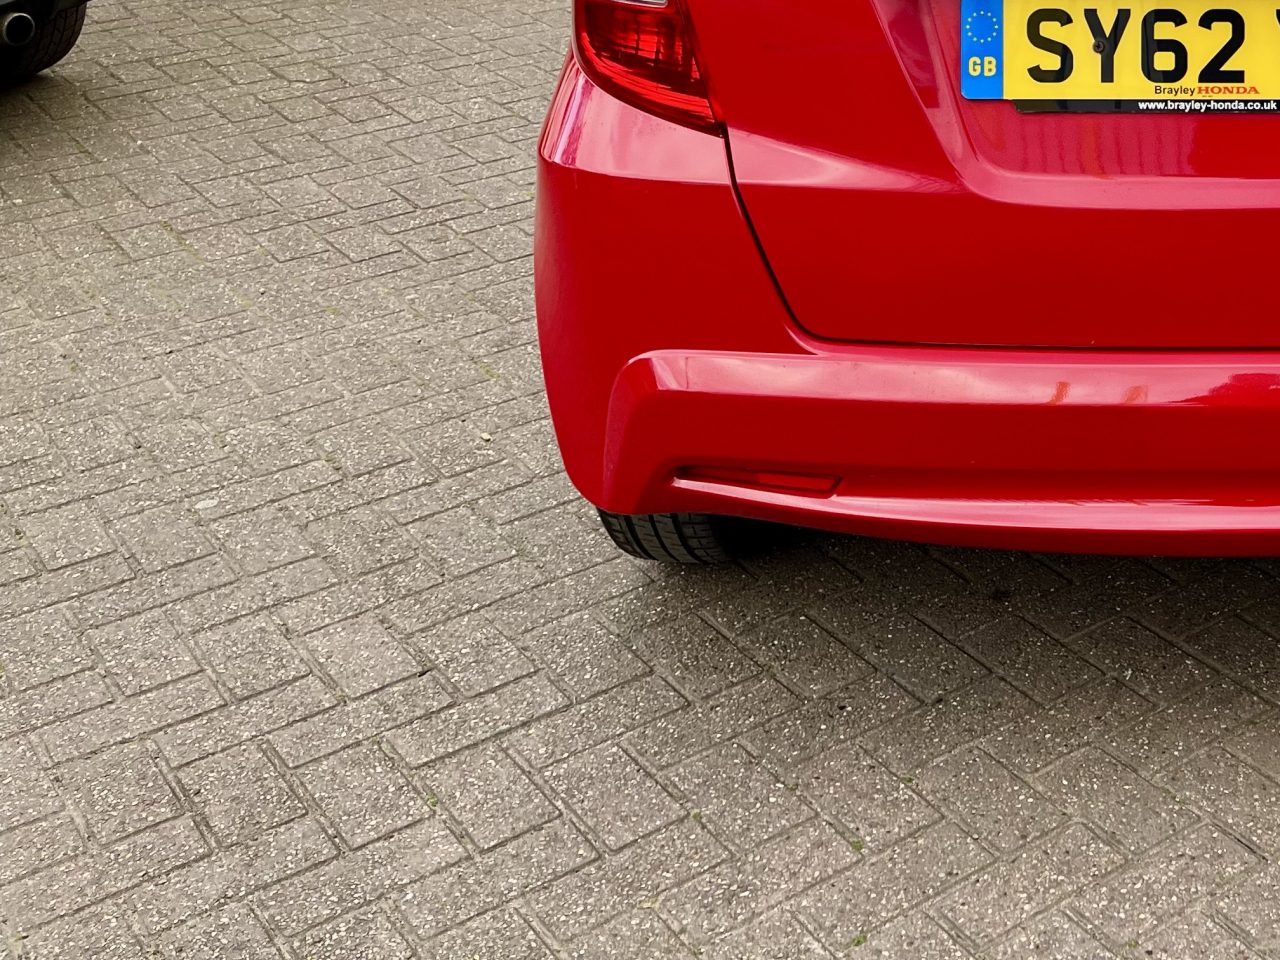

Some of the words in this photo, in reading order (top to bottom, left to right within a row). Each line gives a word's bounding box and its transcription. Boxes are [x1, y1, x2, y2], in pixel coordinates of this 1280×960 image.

[1026, 8, 1245, 84] SY62
[968, 56, 997, 77] GB
[1154, 85, 1196, 97] Brayley
[1197, 86, 1261, 95] HONDA
[1138, 100, 1278, 113] www.brayley-honda.co.uk
